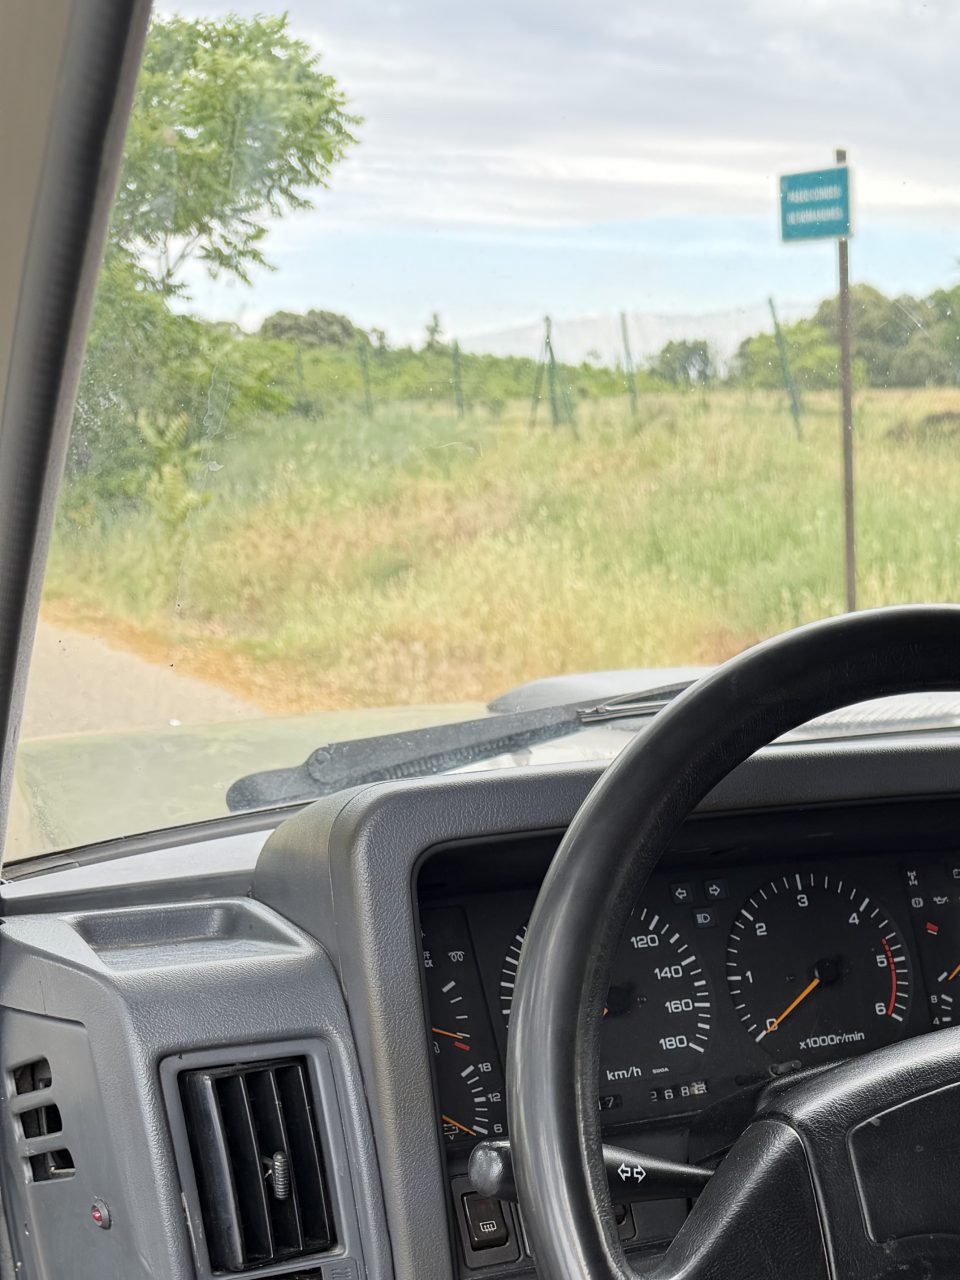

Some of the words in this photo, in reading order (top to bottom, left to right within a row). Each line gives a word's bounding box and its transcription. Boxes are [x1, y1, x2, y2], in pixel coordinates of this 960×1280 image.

[797, 894, 809, 907] 3
[849, 912, 860, 925] 4
[755, 922, 768, 936] 2
[630, 934, 659, 949] 120
[876, 954, 888, 967] 5
[654, 965, 683, 980] 140
[745, 970, 753, 983] 1
[665, 999, 693, 1013] 160
[875, 1002, 887, 1016] 6
[659, 1035, 688, 1050] 180
[799, 1031, 865, 1050] x1000r/min
[478, 1062, 492, 1072] 18
[606, 1066, 642, 1080] km/h
[487, 1092, 501, 1102] 12
[493, 1123, 503, 1133] 6
